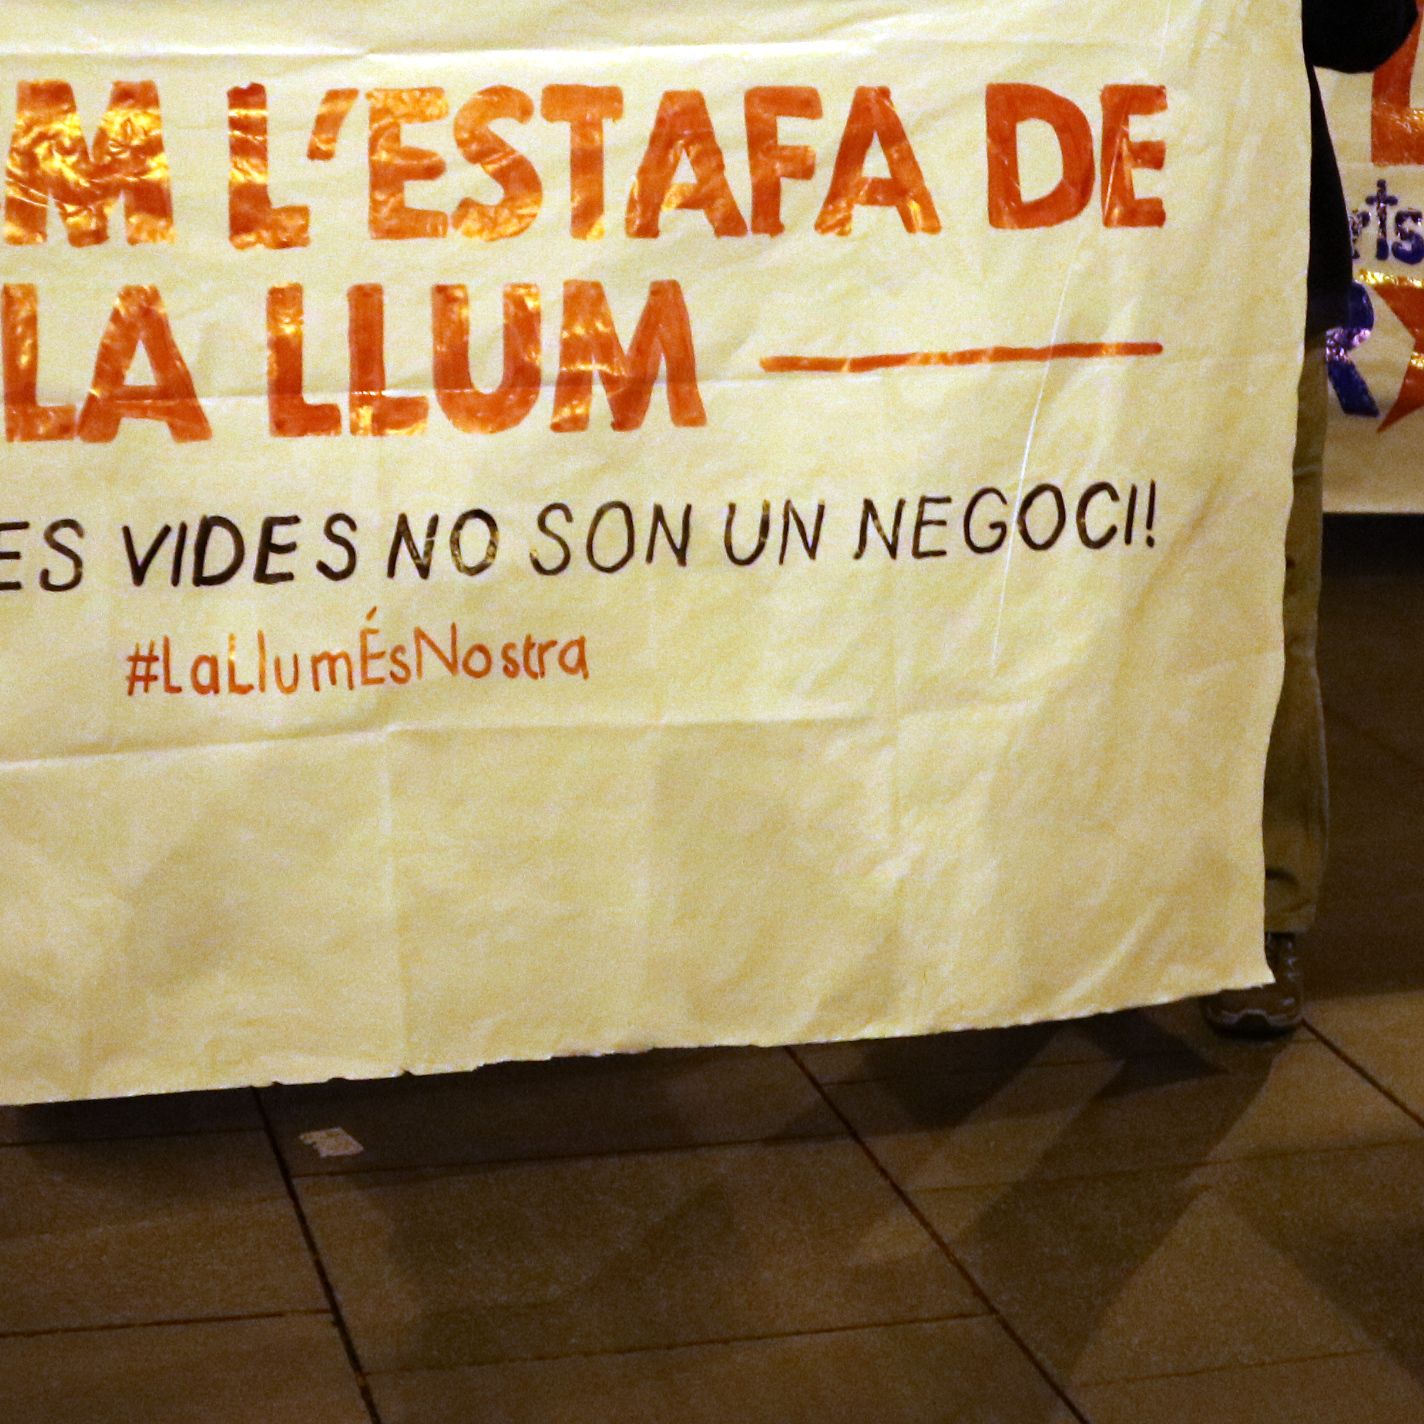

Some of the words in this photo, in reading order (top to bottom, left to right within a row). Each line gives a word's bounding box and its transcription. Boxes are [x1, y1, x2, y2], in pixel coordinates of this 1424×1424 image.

[227, 80, 943, 250] L'ESTAFA
[984, 81, 1168, 230] DE
[266, 278, 709, 438] LLUM
[120, 511, 359, 588] VIDES
[386, 507, 501, 580] NO
[529, 500, 692, 577] SON
[723, 497, 826, 568] UN
[853, 478, 1159, 561] NEGOCI!
